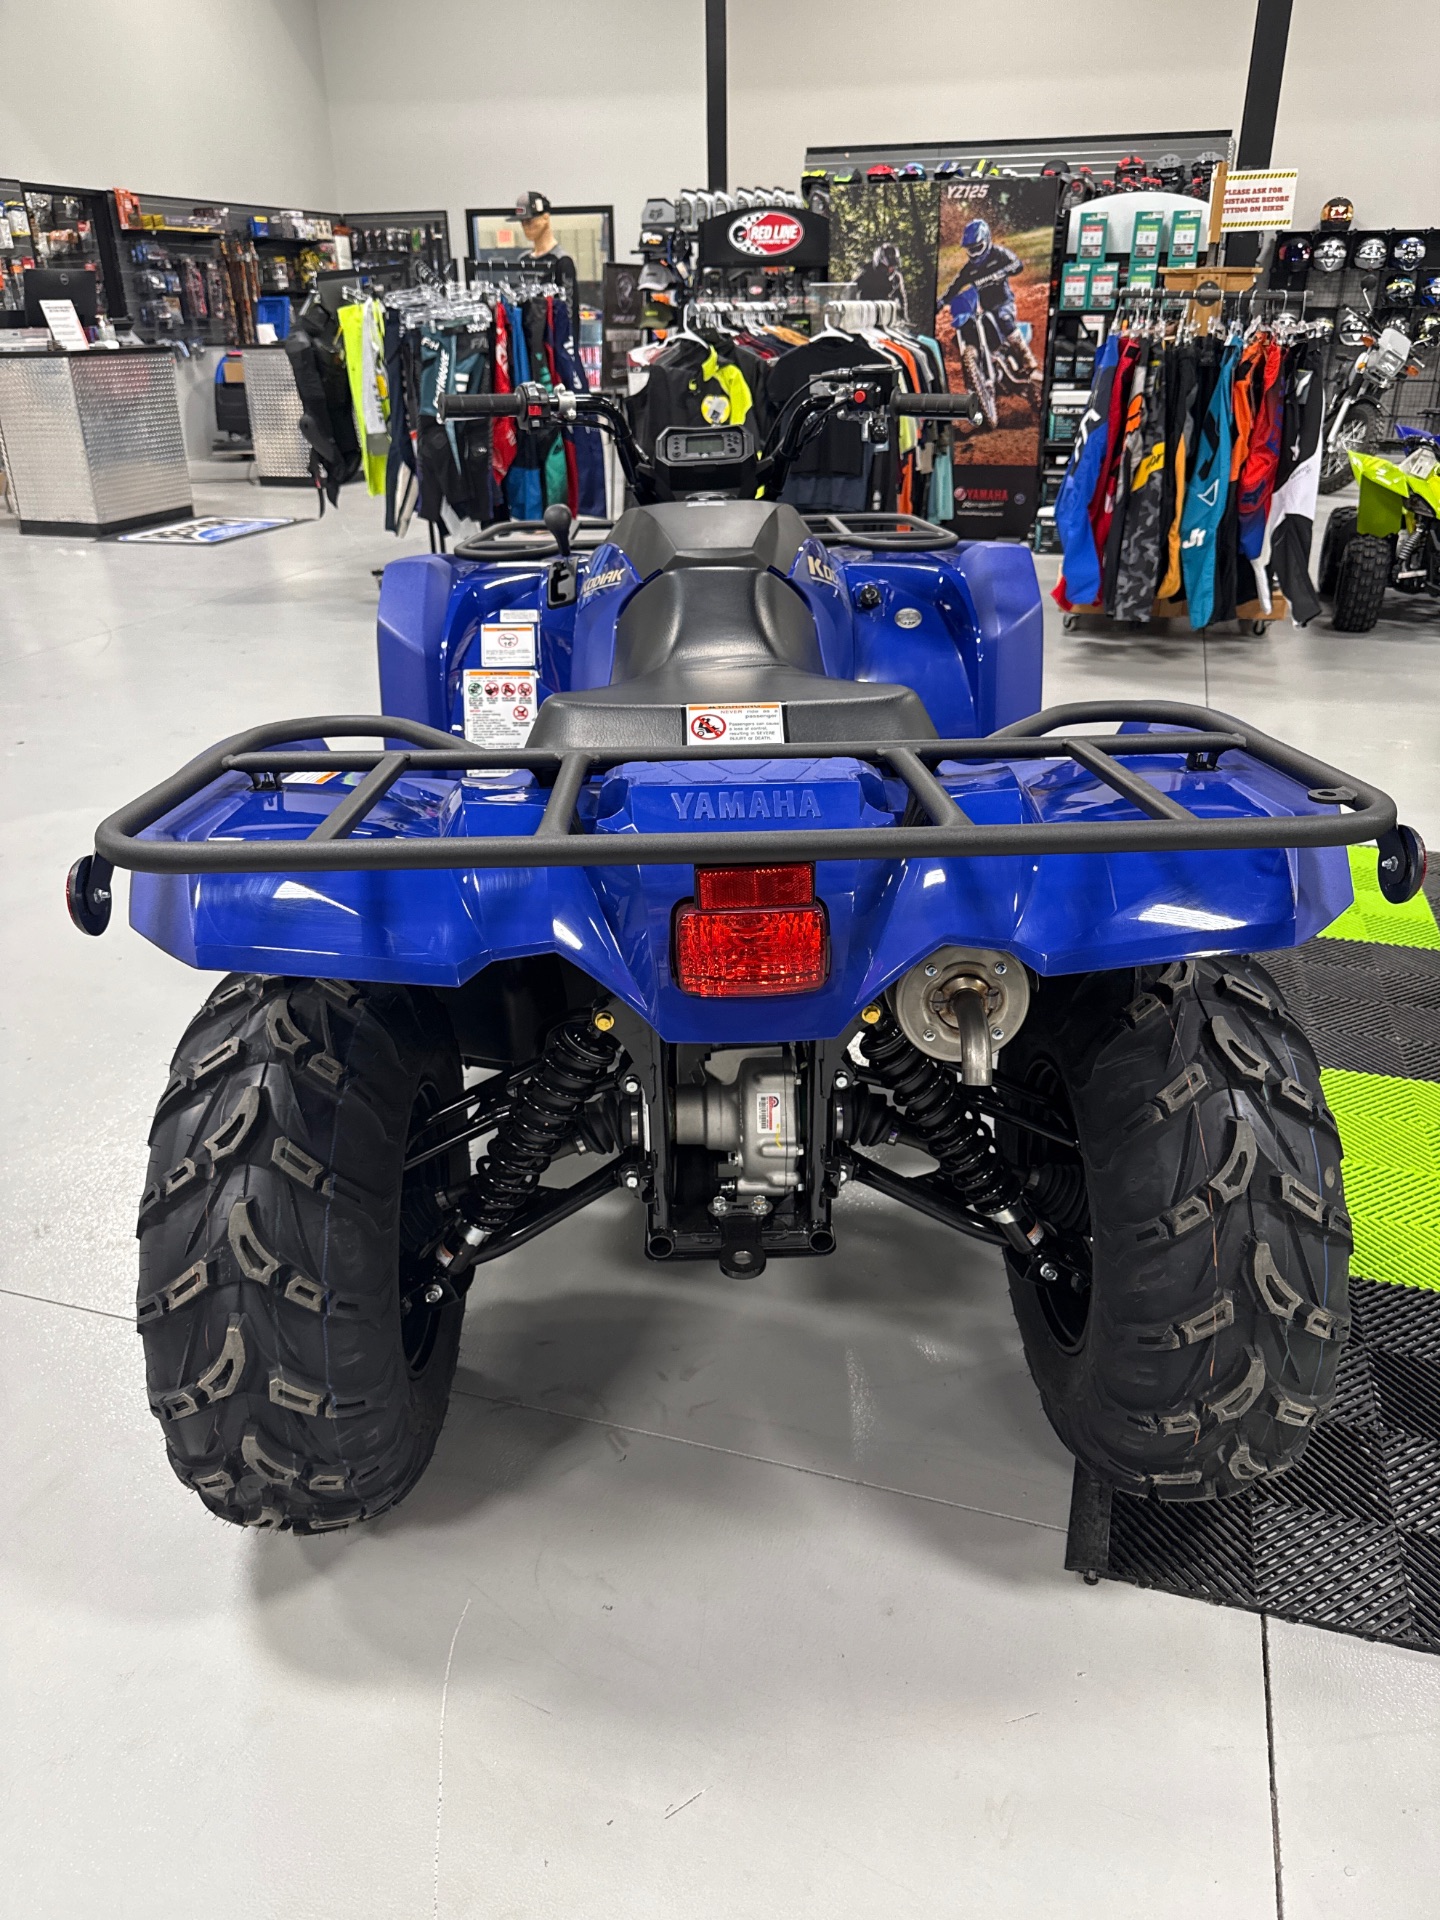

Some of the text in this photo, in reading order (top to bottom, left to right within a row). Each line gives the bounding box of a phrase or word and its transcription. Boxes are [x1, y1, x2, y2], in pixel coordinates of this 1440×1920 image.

[947, 184, 990, 199] YZ125
[1225, 186, 1283, 196] PLEASE ASK FOR
[1223, 195, 1290, 205] SISTANCE BEFORE
[1222, 206, 1249, 214] ITTING
[1262, 204, 1284, 212] BIKES
[750, 223, 798, 240] RED LINE
[966, 488, 1009, 501] YAMAHA
[582, 568, 626, 593] KODIAK
[670, 789, 822, 822] YAMAHA
